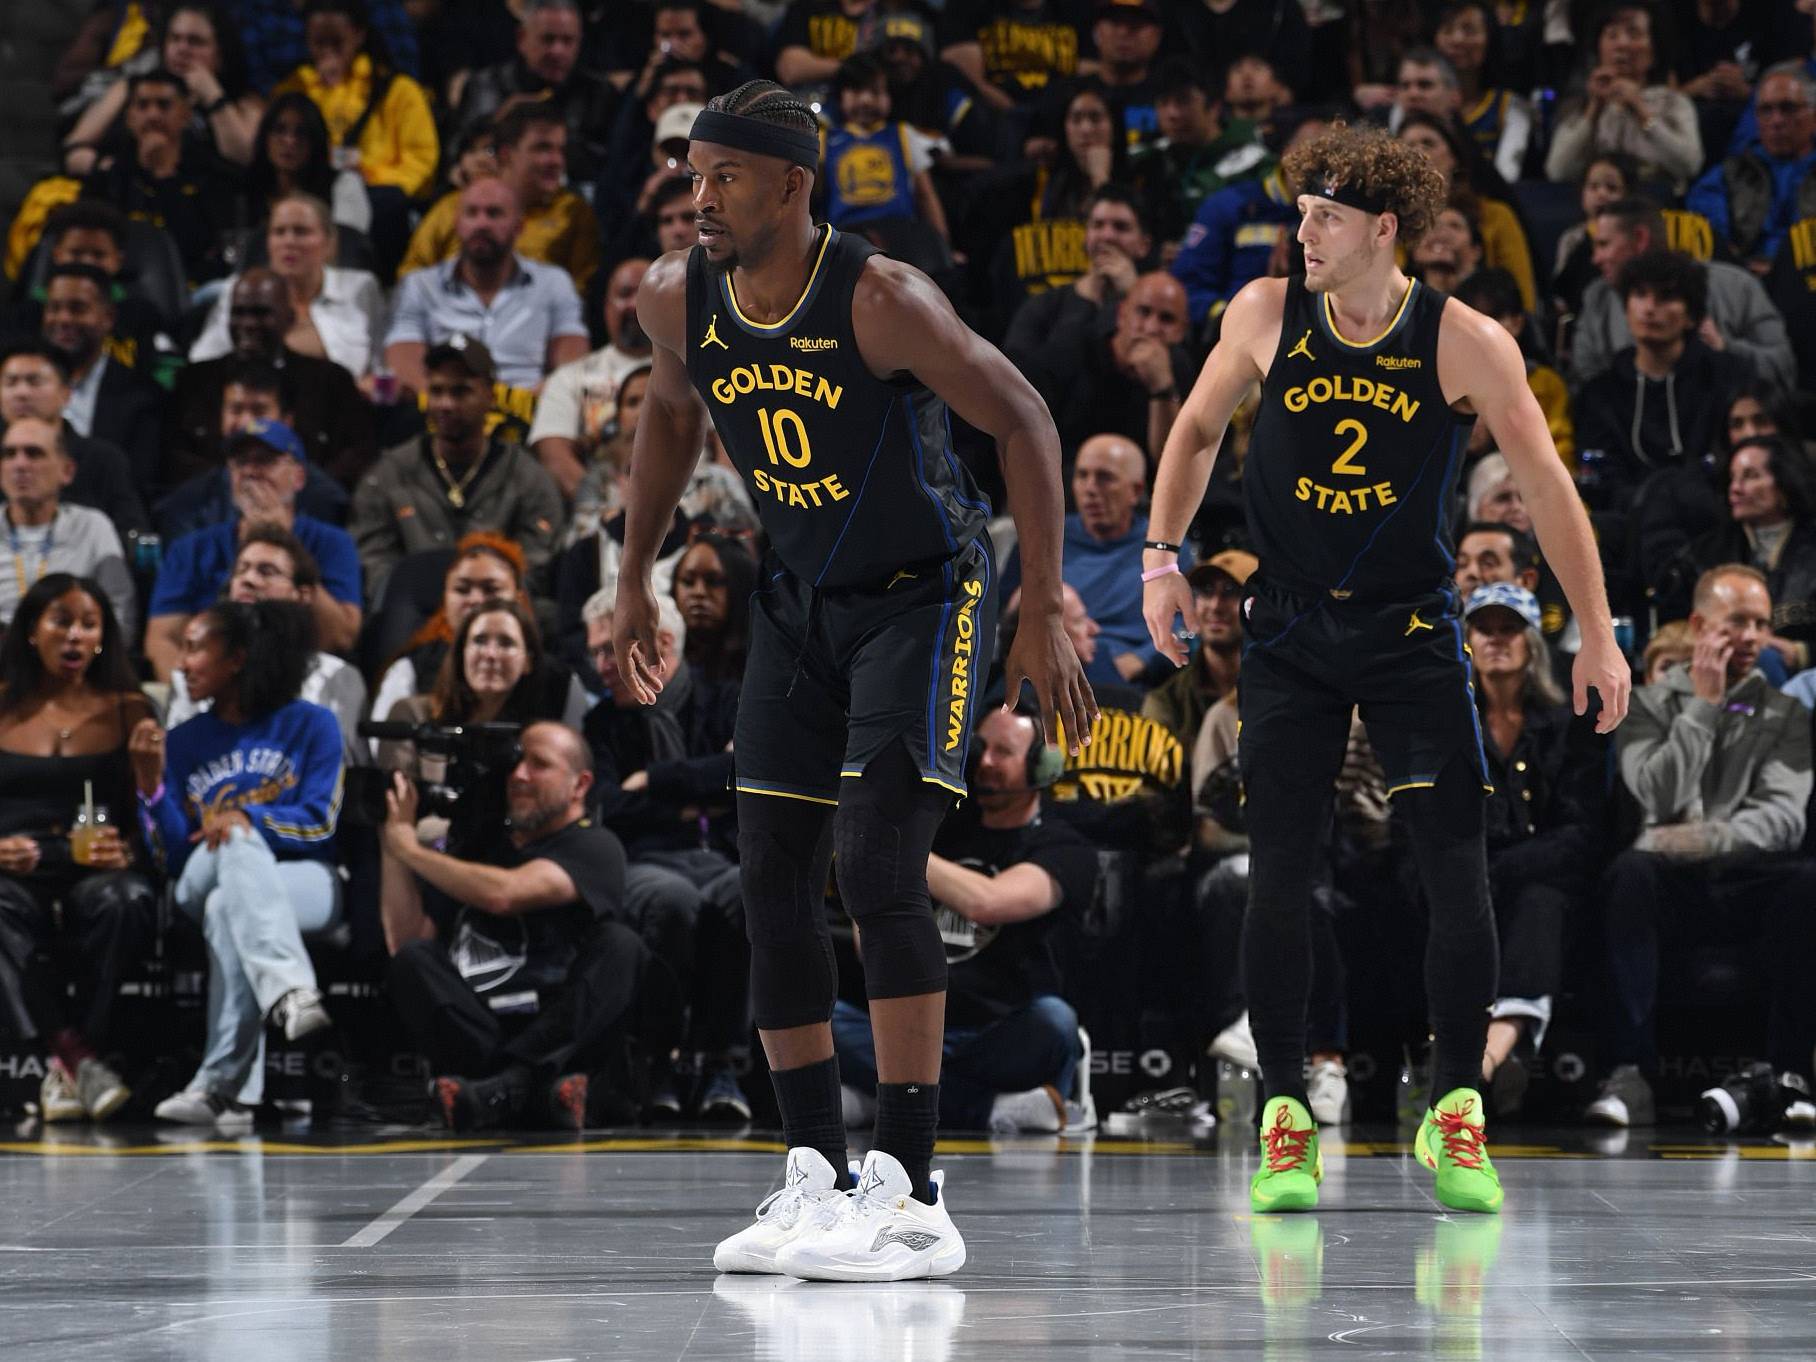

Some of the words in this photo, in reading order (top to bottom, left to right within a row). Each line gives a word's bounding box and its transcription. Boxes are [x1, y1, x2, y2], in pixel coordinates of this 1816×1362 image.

[790, 337, 838, 350] Rakuten
[1376, 356, 1421, 368] Rakuten
[711, 364, 843, 409] GOLDEN
[1284, 375, 1420, 423] GOLDEN
[757, 408, 812, 468] 10
[1332, 419, 1368, 475] 2
[753, 469, 850, 509] STATE
[1295, 477, 1397, 514] STATE
[946, 580, 983, 751] WARRIORS
